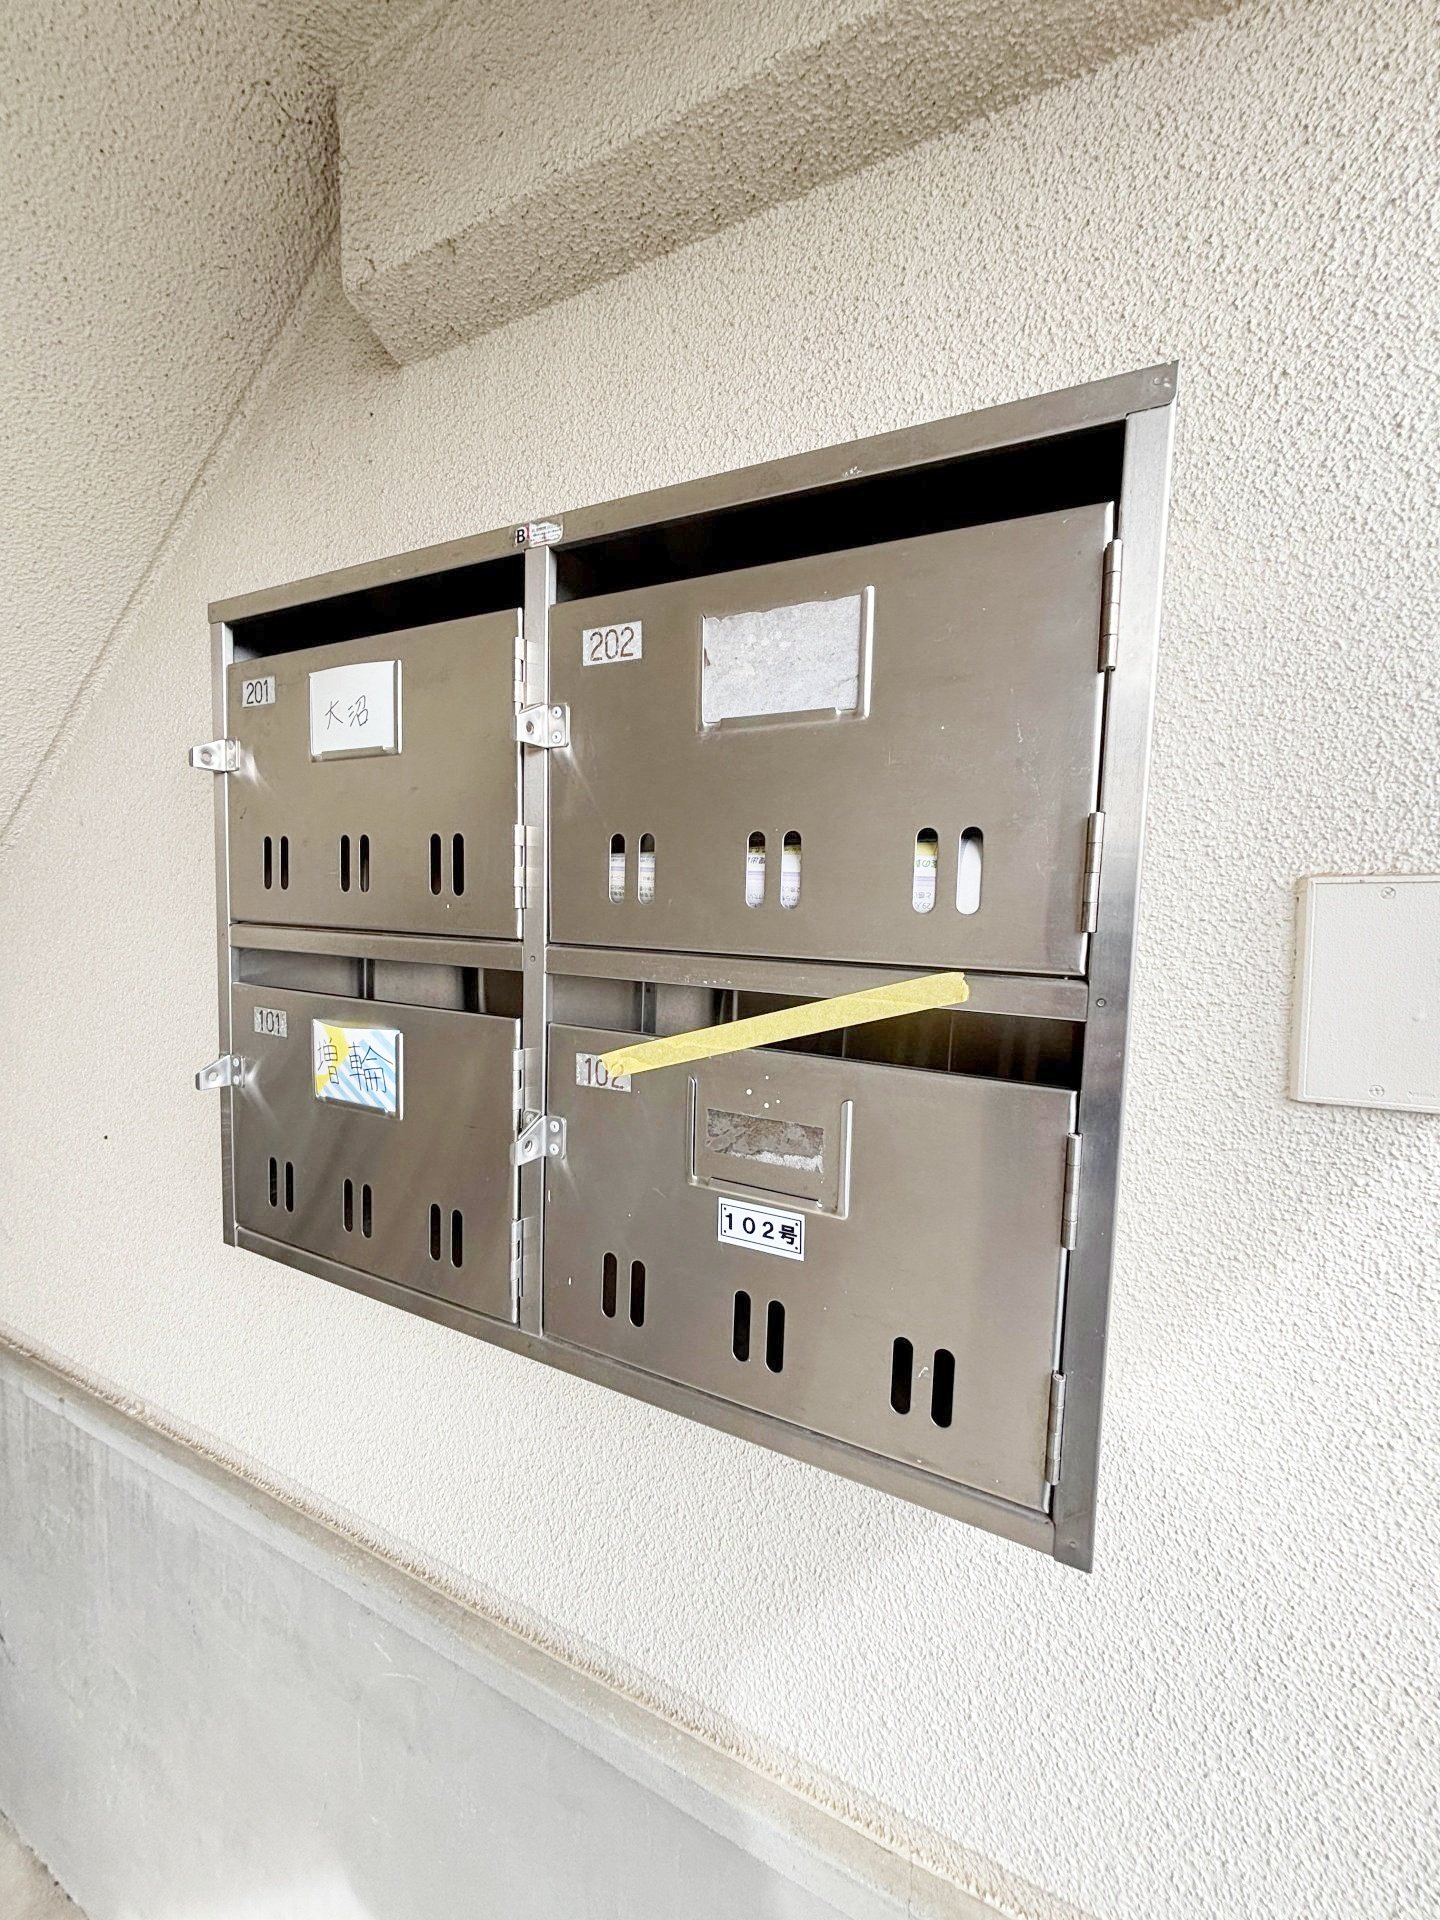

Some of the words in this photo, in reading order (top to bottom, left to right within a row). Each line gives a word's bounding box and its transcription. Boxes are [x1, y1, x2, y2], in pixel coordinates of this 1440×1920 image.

[517, 529, 526, 543] B
[590, 626, 634, 661] 202
[246, 679, 269, 705] 201
[258, 1009, 281, 1035] 101
[725, 1212, 798, 1246] 102号
